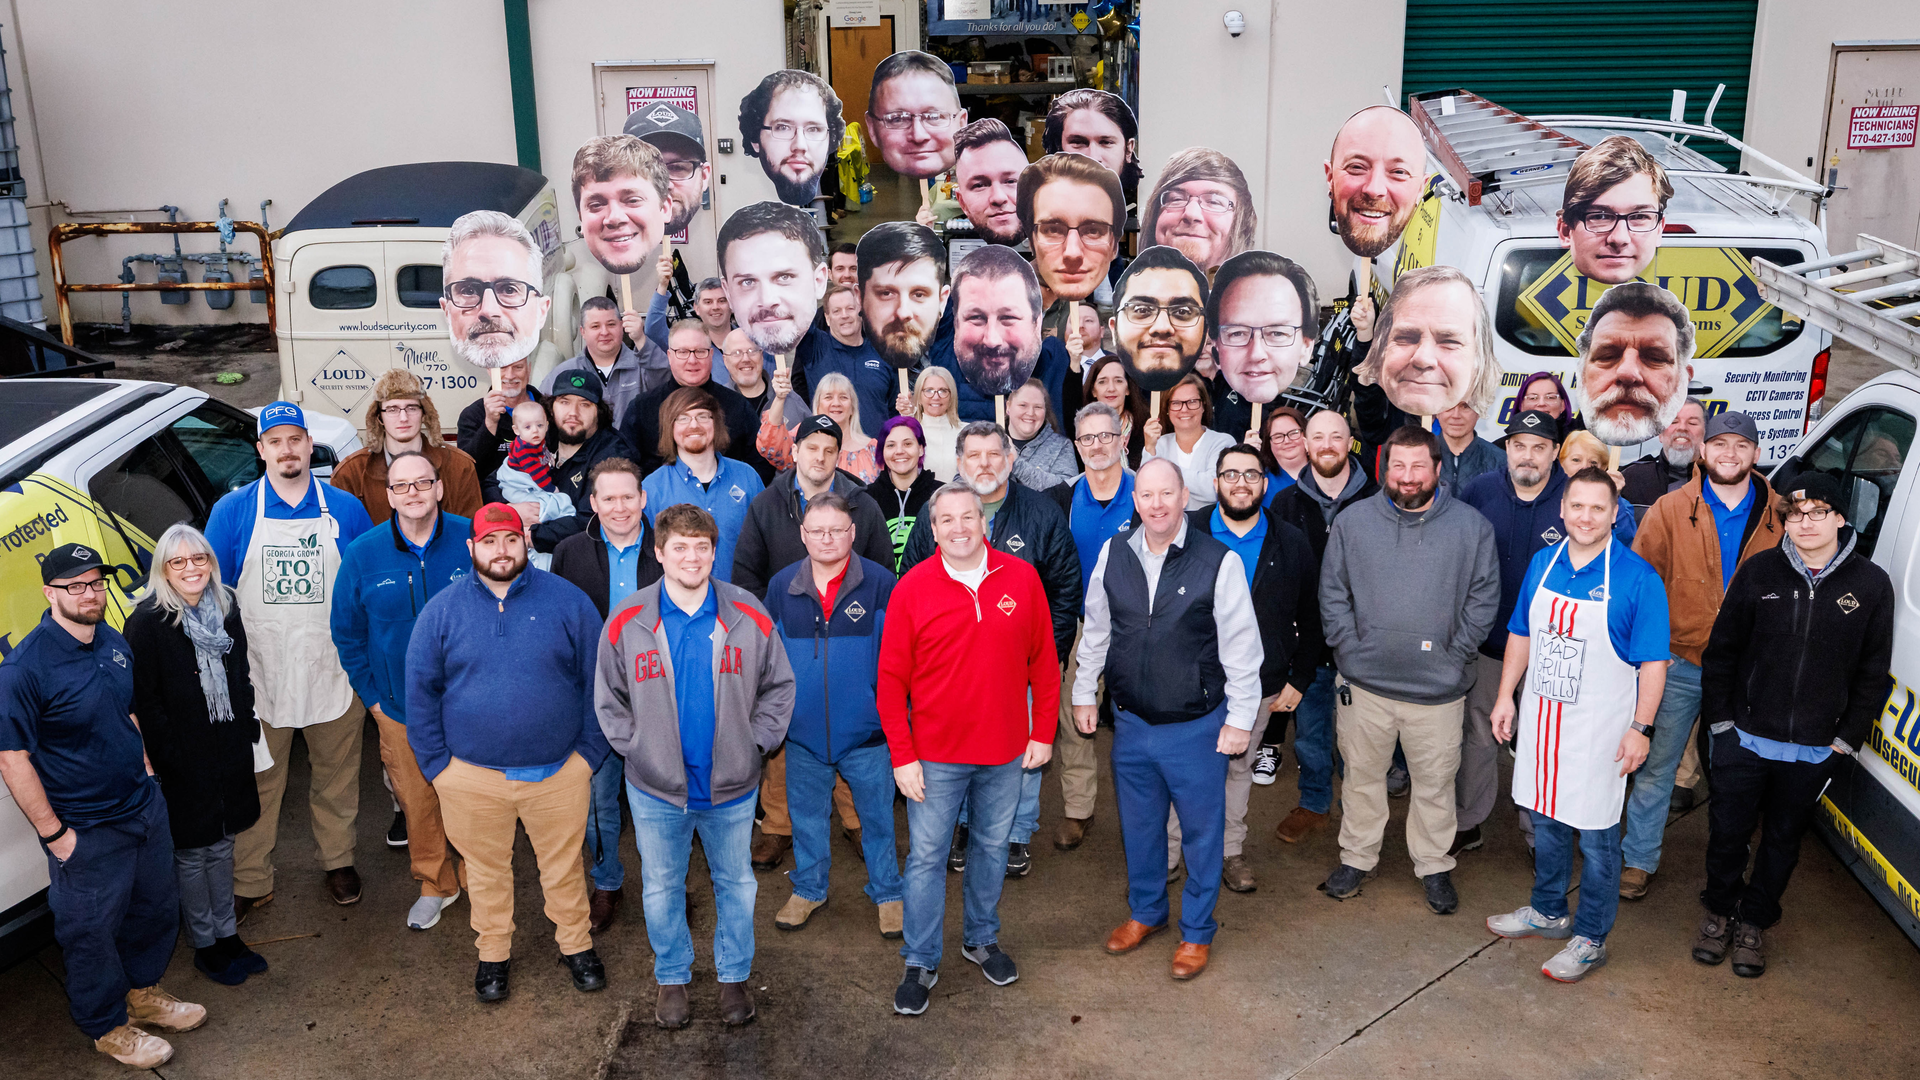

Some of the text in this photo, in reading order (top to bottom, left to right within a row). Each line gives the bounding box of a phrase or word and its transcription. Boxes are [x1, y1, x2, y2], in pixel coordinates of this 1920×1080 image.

[843, 15, 867, 23] Google
[967, 22, 1057, 34] Thanks for all you do!
[629, 87, 695, 98] NOW HIRING
[1853, 106, 1918, 118] NOW HIRING
[1853, 119, 1915, 132] TECHNICIANS
[1852, 132, 1913, 144] 770-427-1300
[1519, 166, 1545, 174] WERNER
[338, 320, 437, 333] www.loudsecurity.com
[422, 363, 450, 372] (770)
[323, 369, 366, 380] LOUD
[1724, 370, 1807, 384] Security Monitoring
[1745, 390, 1805, 402] CCTV Cameras
[265, 405, 298, 419] PFG
[1773, 408, 1803, 420] Control
[1767, 428, 1800, 441] Systems
[0, 502, 69, 554] rotected
[266, 549, 321, 558] GEORGIA GROWN
[276, 559, 310, 577] TO
[276, 578, 312, 595] GO
[1540, 636, 1578, 660] MAD
[1537, 652, 1576, 678] GRILL
[1534, 673, 1578, 698] SKILLS
